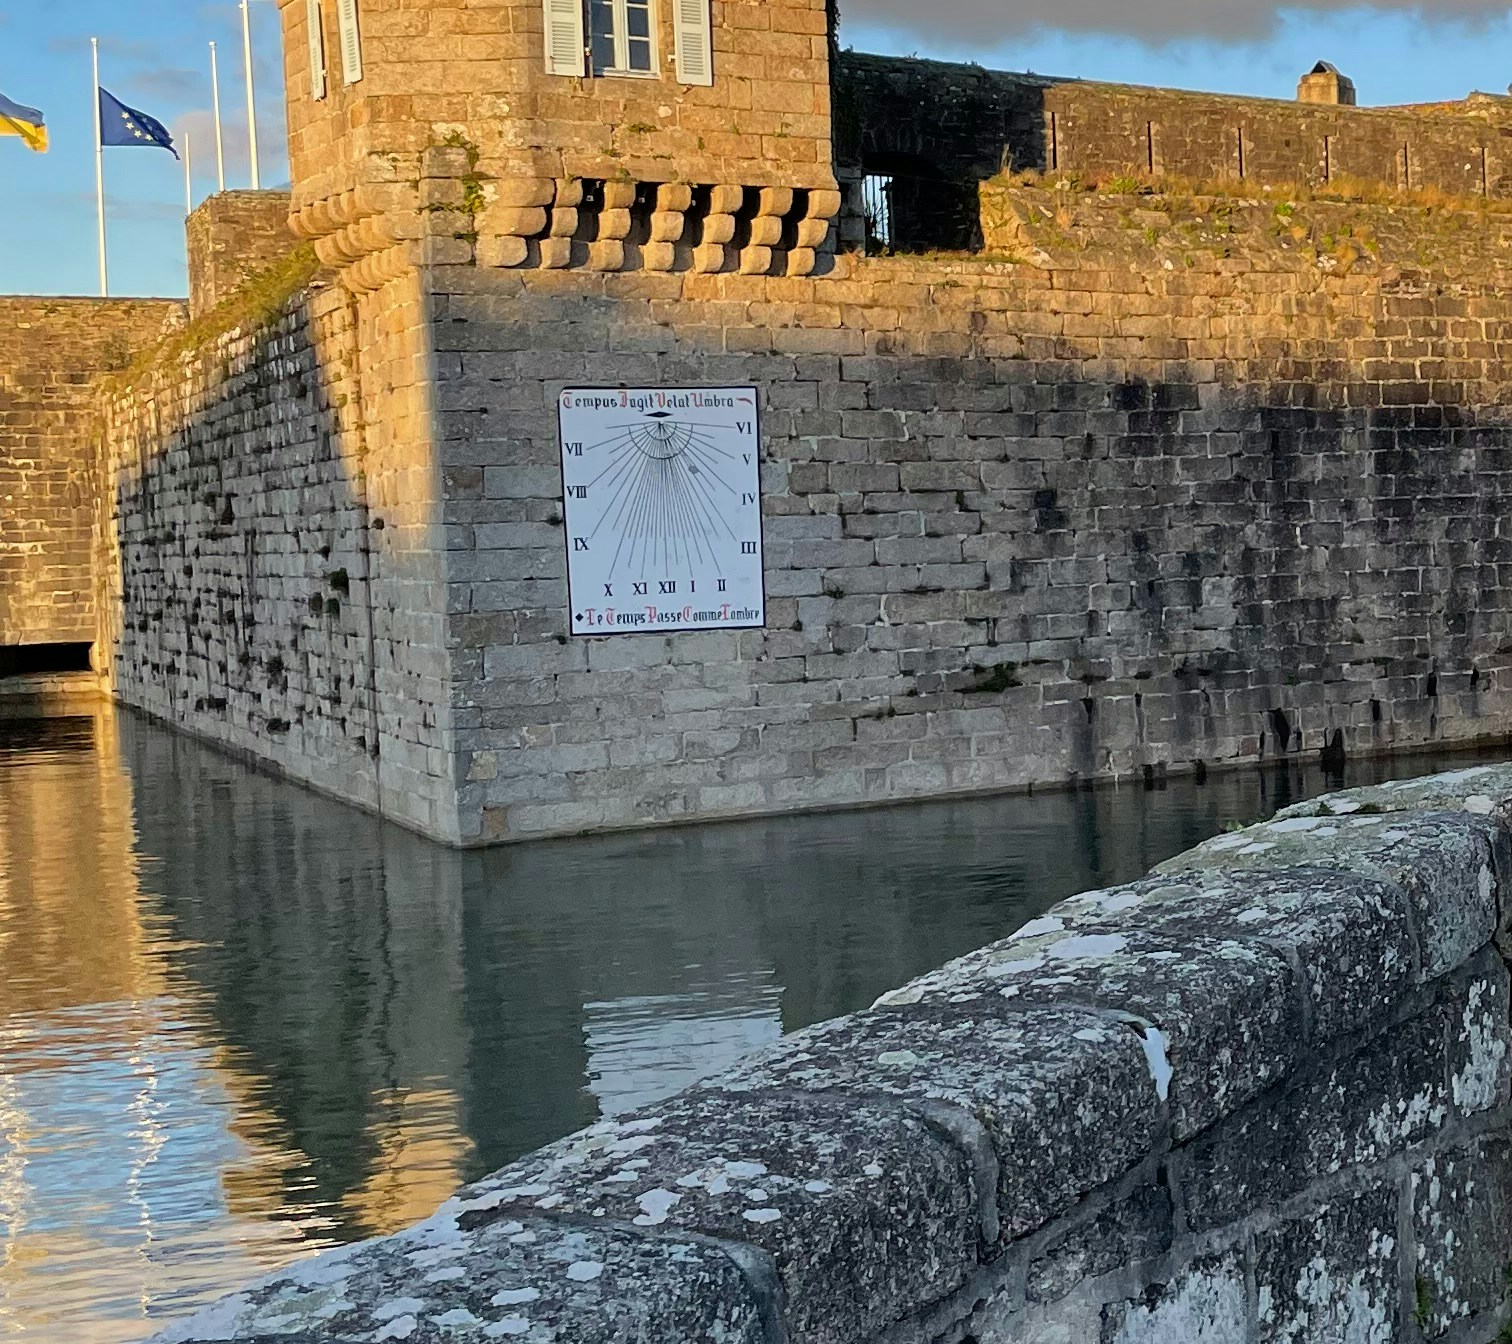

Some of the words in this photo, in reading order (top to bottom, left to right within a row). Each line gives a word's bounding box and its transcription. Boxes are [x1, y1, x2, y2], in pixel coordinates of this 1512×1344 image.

[562, 391, 618, 411] Tempus
[690, 392, 734, 408] Umbra
[735, 422, 752, 435] VI
[565, 442, 583, 457] VII
[742, 453, 752, 466] V
[566, 485, 588, 499] VIII
[741, 493, 756, 505] IV
[573, 537, 590, 551] IX
[740, 541, 757, 554] III
[604, 583, 613, 596] X
[632, 582, 648, 595] XI
[658, 580, 677, 594] XII
[690, 580, 696, 593] I
[717, 579, 727, 592] II
[585, 607, 603, 626] Le
[605, 607, 646, 626] Temps
[644, 605, 682, 624] Passe
[682, 605, 722, 623] Comme
